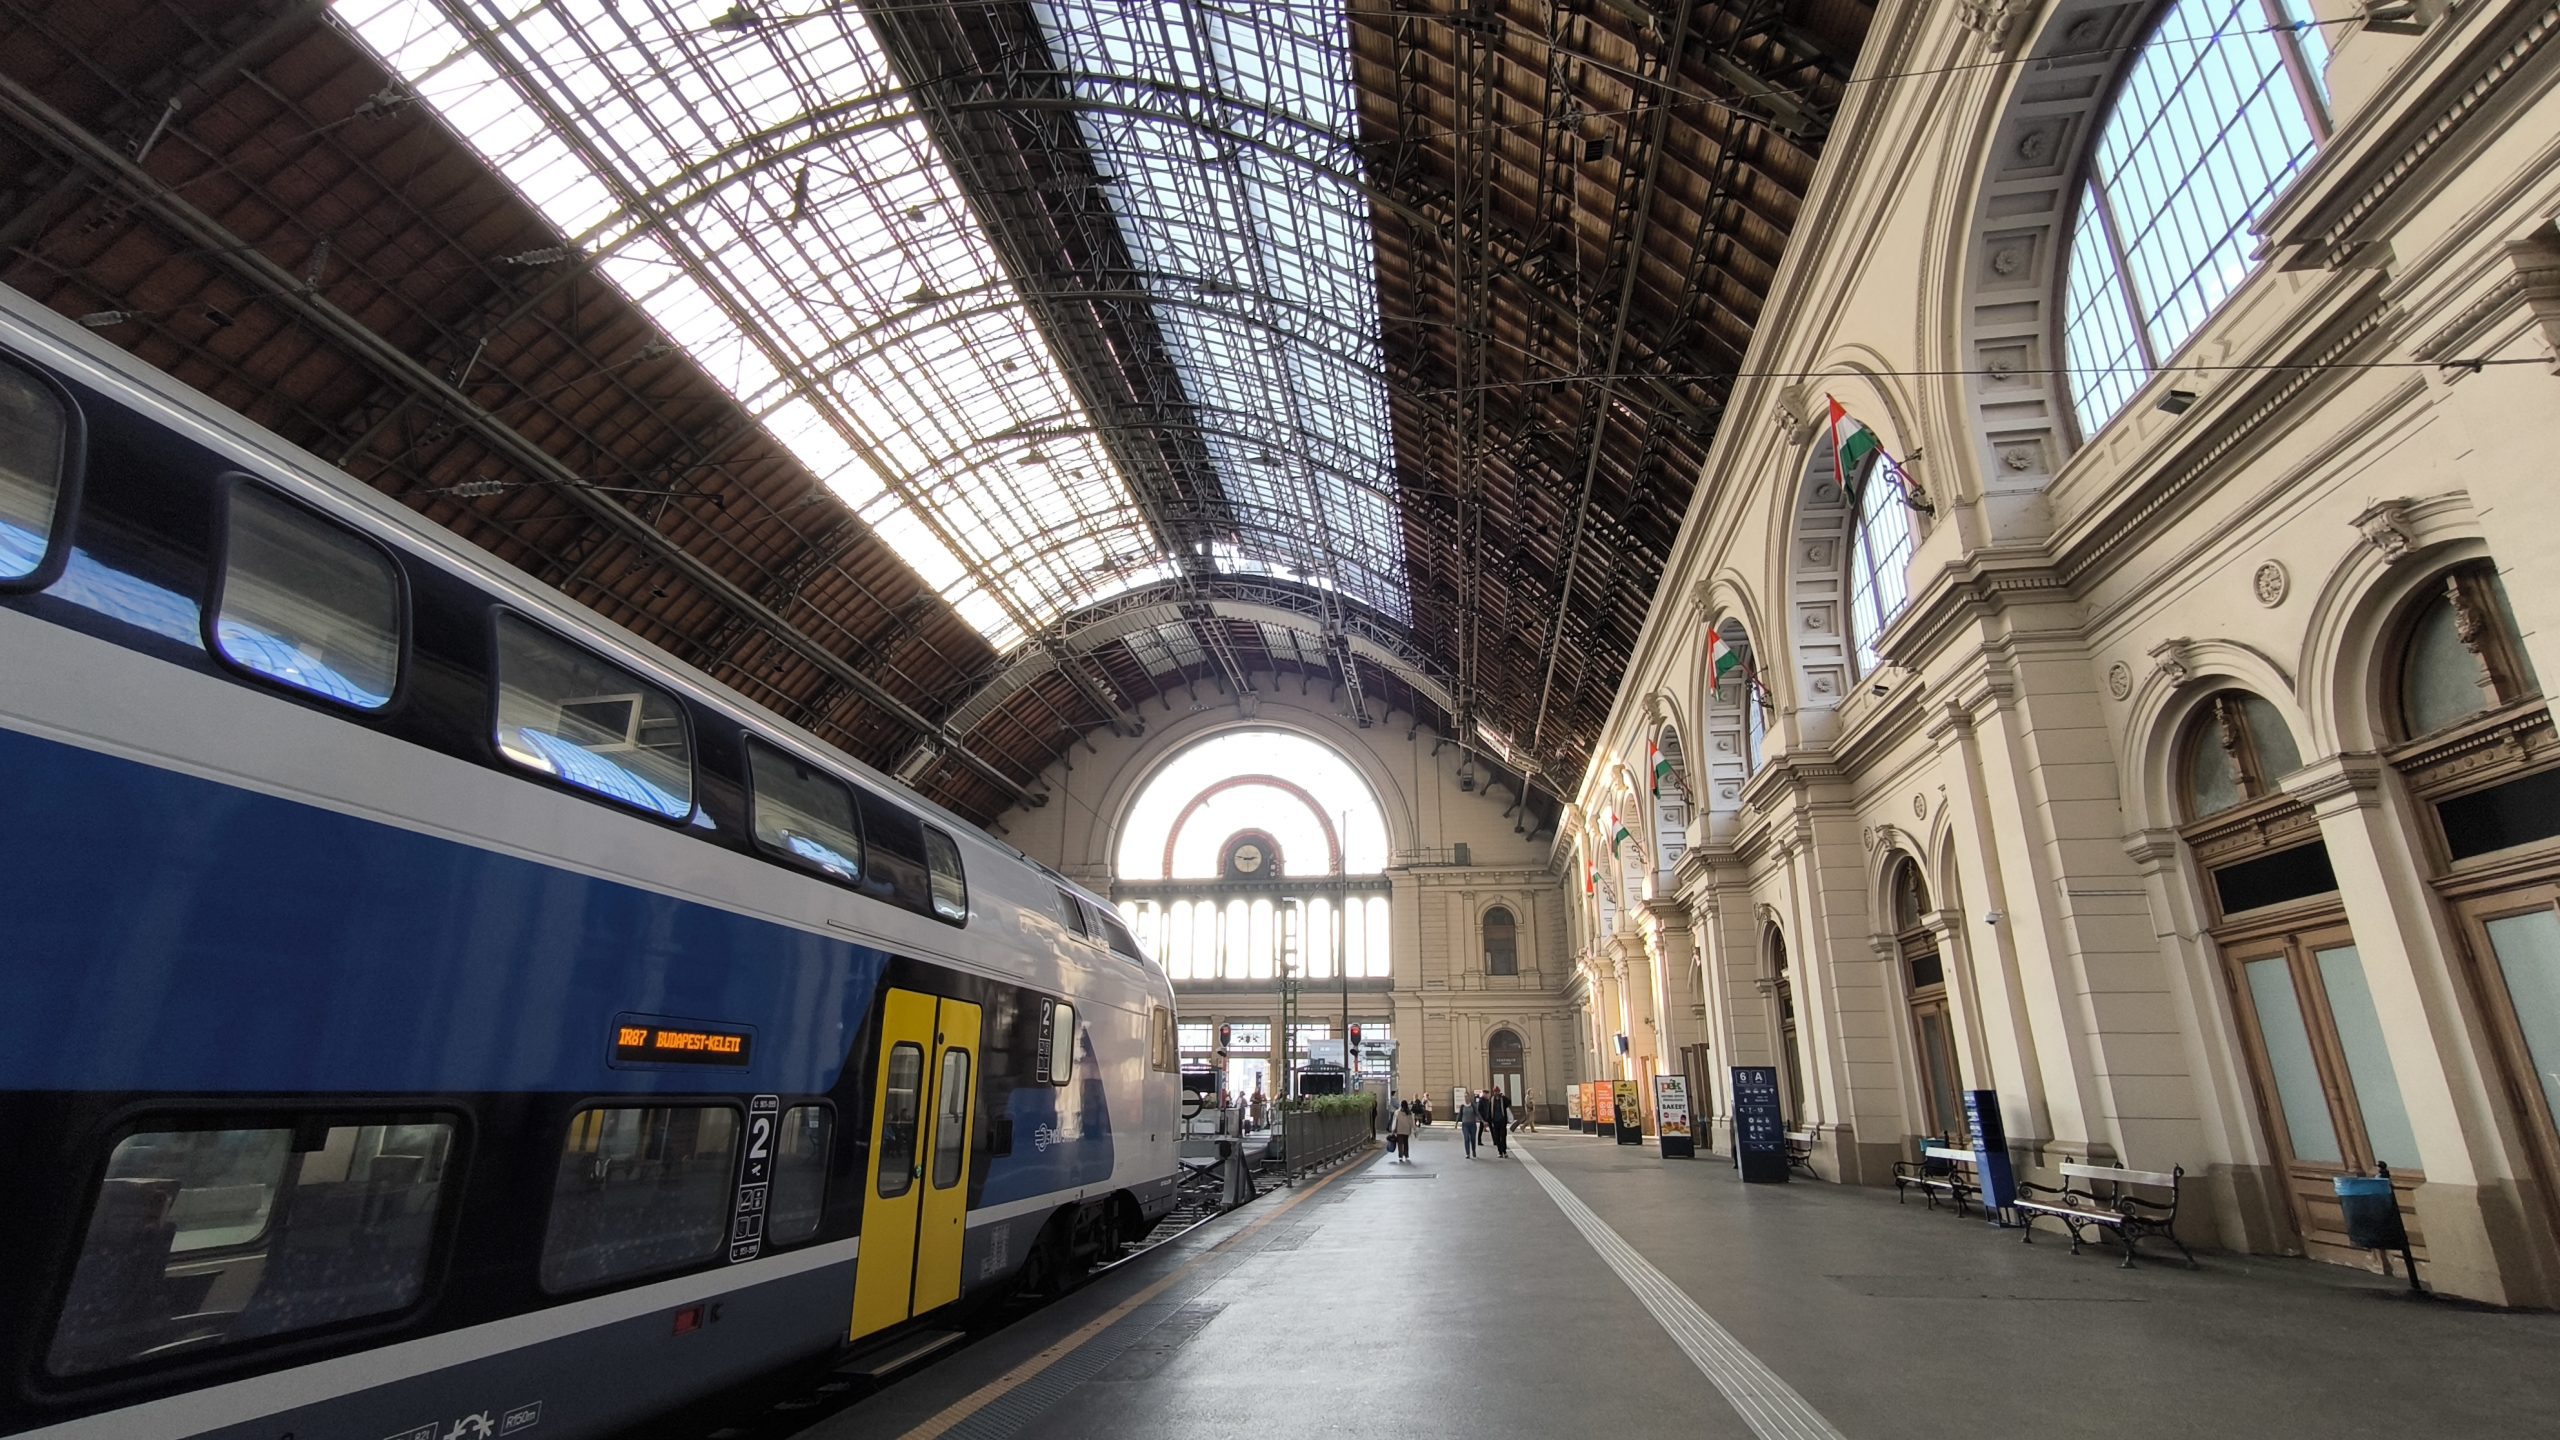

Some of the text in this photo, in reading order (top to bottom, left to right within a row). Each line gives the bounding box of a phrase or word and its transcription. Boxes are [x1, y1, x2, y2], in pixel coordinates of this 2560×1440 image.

[1042, 1002, 1050, 1026] 2
[618, 1028, 741, 1053] IR87 BUDAPEST-KELETI
[1740, 1072, 1747, 1081] 6
[1755, 1072, 1763, 1081] A
[749, 1117, 770, 1159] 2
[505, 1410, 537, 1429] R150m
